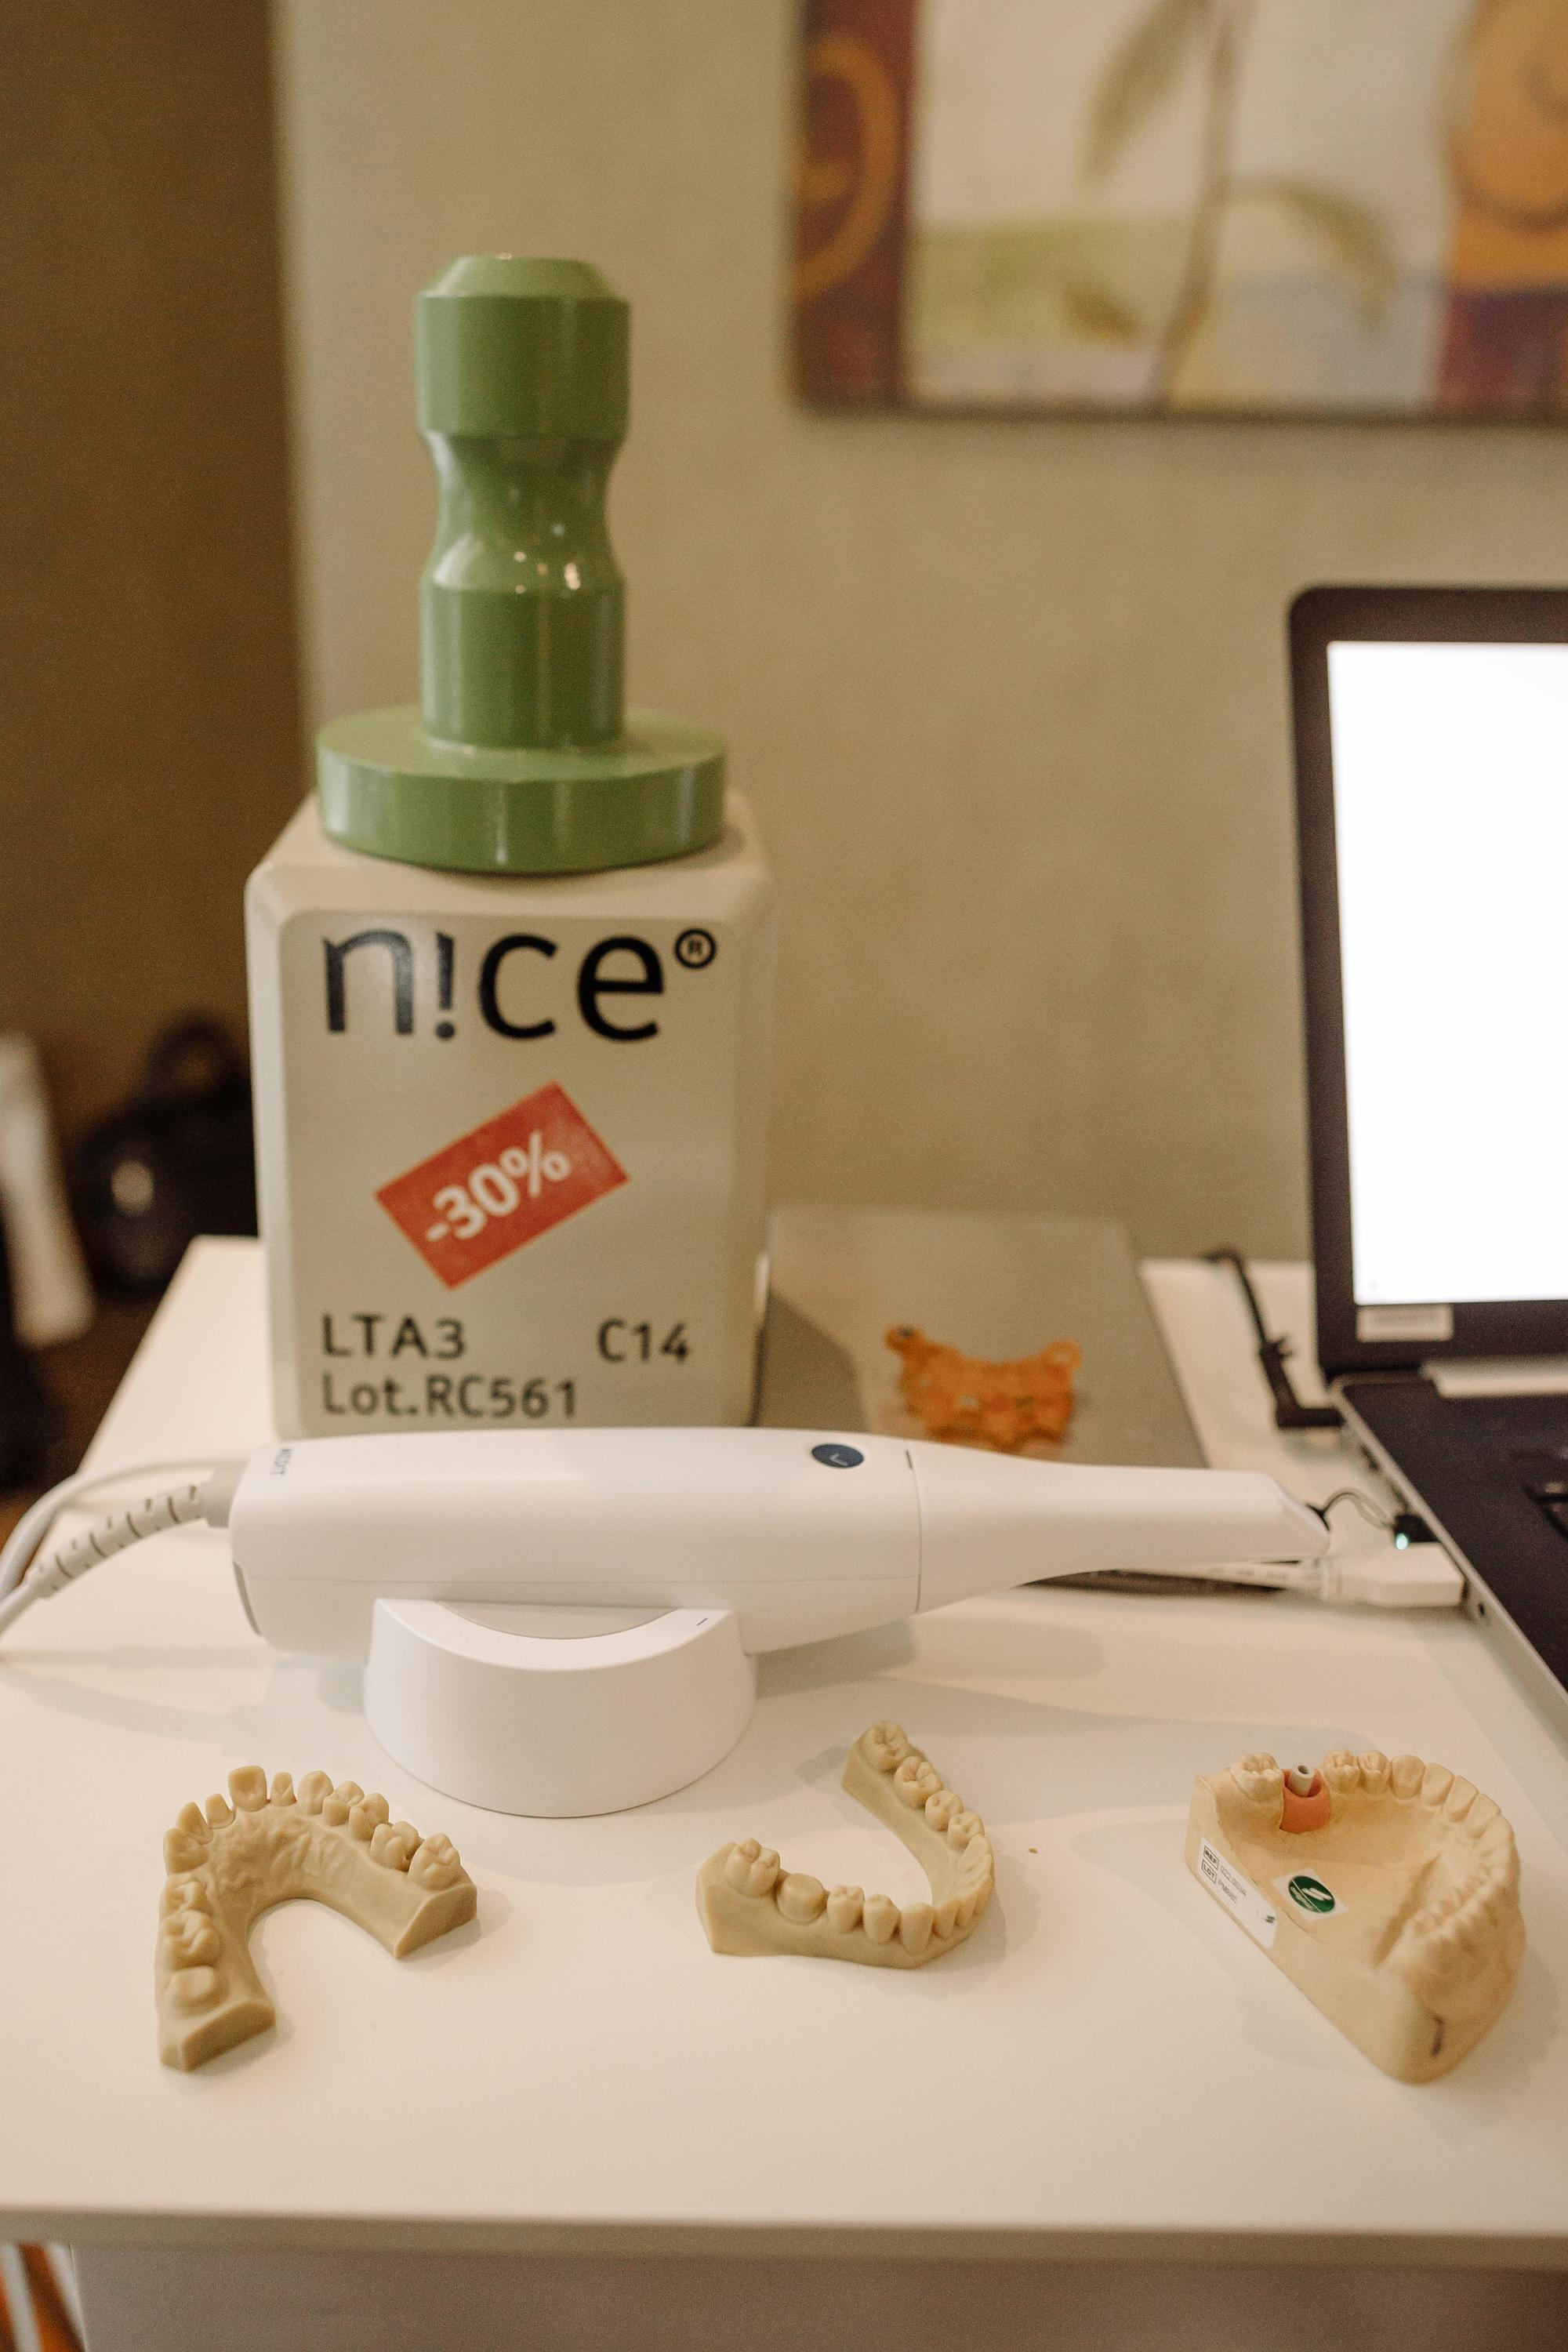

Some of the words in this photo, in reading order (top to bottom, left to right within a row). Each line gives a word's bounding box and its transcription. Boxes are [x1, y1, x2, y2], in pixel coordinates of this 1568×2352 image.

[425, 1129, 572, 1242] -30%
[322, 1313, 466, 1360] LTA3
[597, 1317, 691, 1363] C14
[322, 1371, 578, 1418] Lot.RC561
